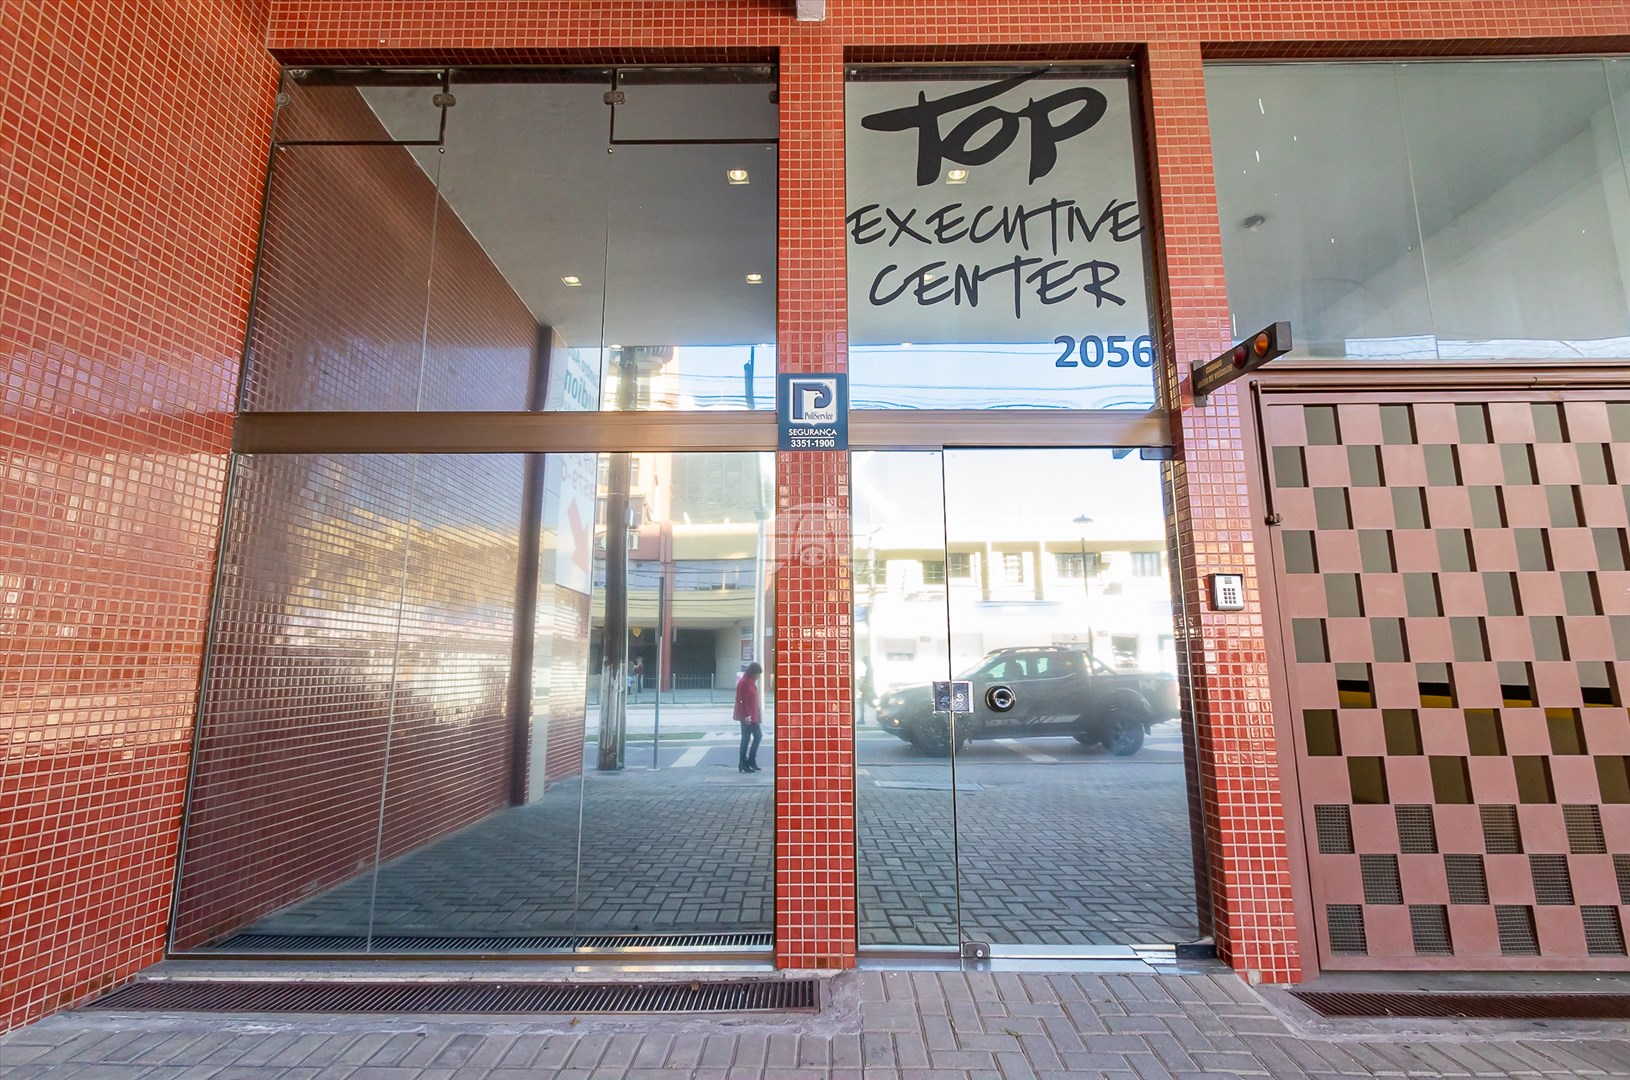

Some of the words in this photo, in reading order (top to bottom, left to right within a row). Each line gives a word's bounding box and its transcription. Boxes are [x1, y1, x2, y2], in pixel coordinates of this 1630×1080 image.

[861, 68, 1107, 186] TOP
[846, 198, 1145, 256] EXECUTIVE
[869, 255, 1126, 319] CENTER
[1054, 335, 1155, 368] 2056
[788, 428, 838, 437] SEGURANÇA
[790, 439, 835, 448] 3351-1900
